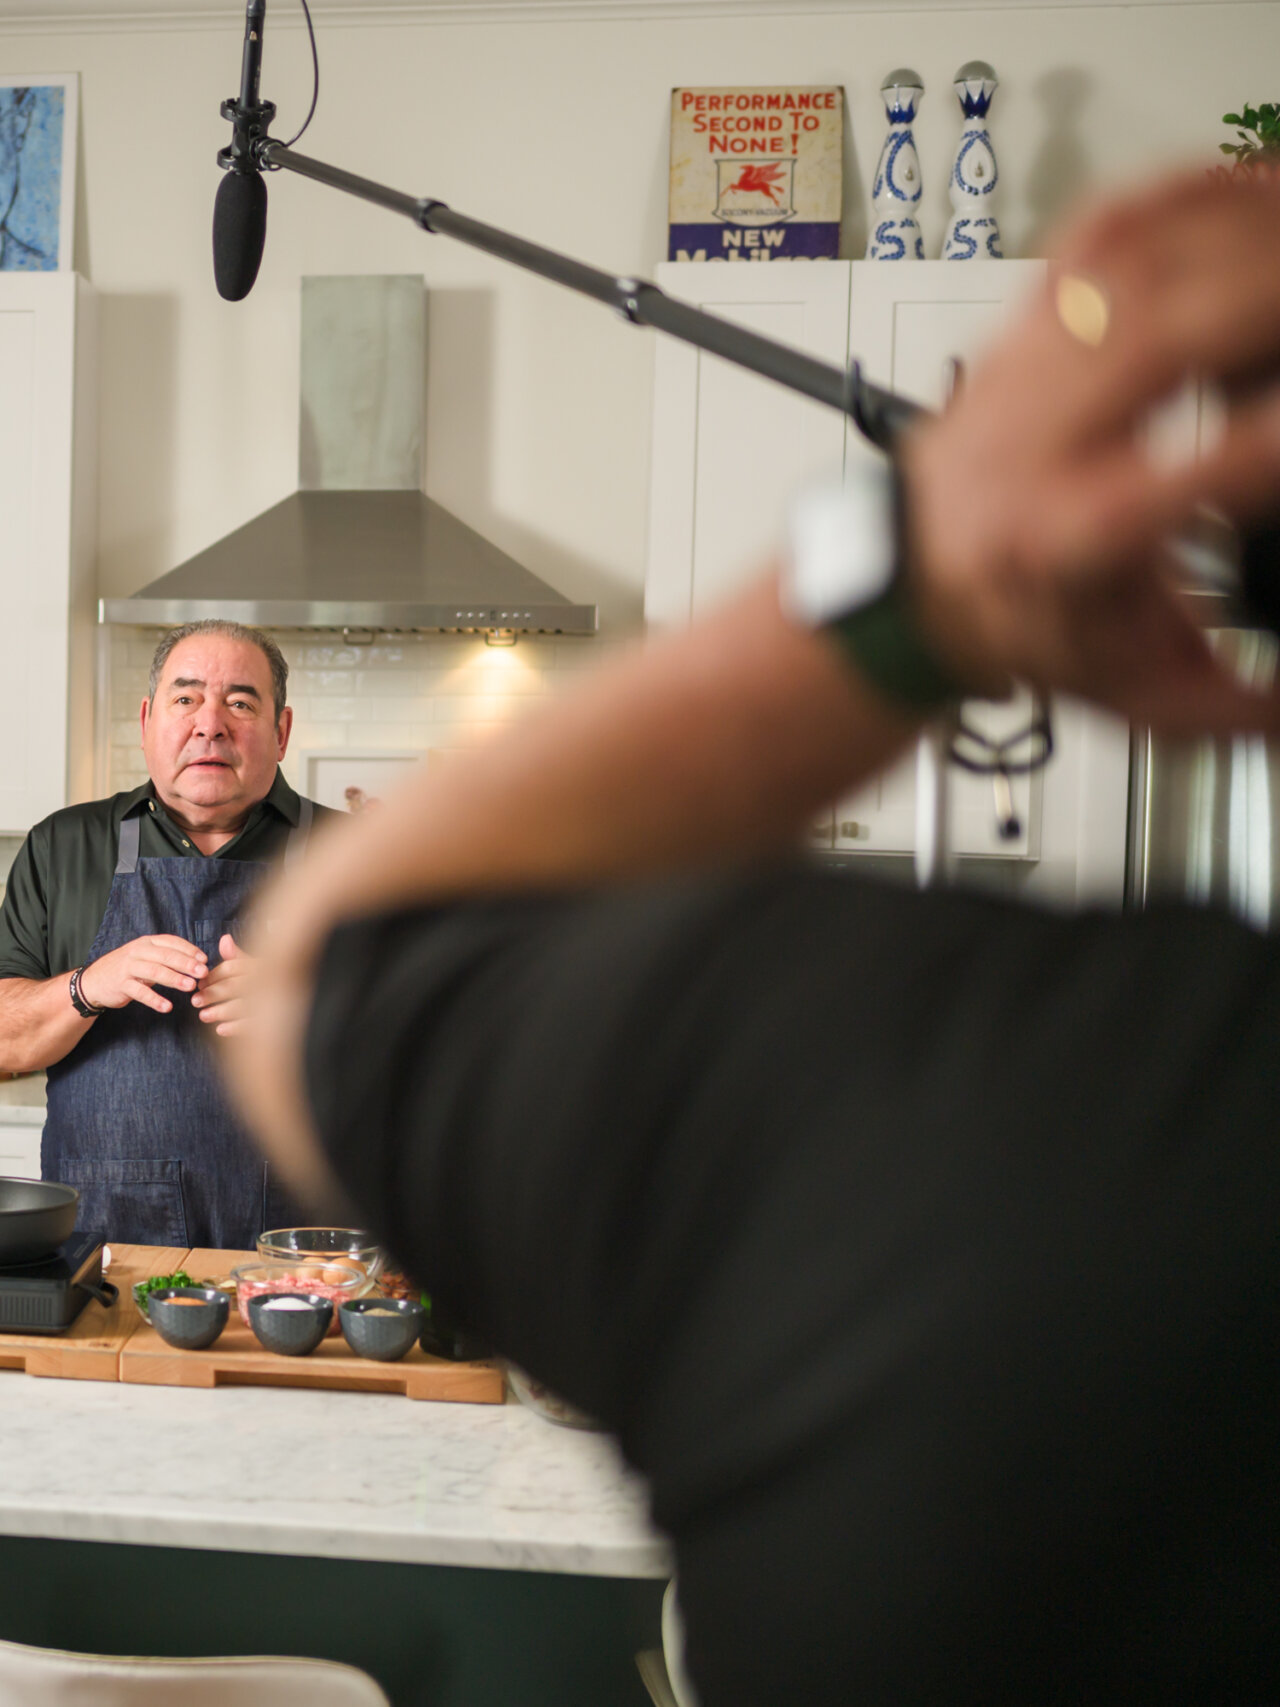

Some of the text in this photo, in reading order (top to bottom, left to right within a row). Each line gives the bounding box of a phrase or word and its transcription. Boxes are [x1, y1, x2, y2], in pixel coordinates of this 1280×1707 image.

[681, 92, 836, 111] PERFORMANCE
[693, 111, 819, 133] SECOND TO
[722, 229, 786, 248] NEW
